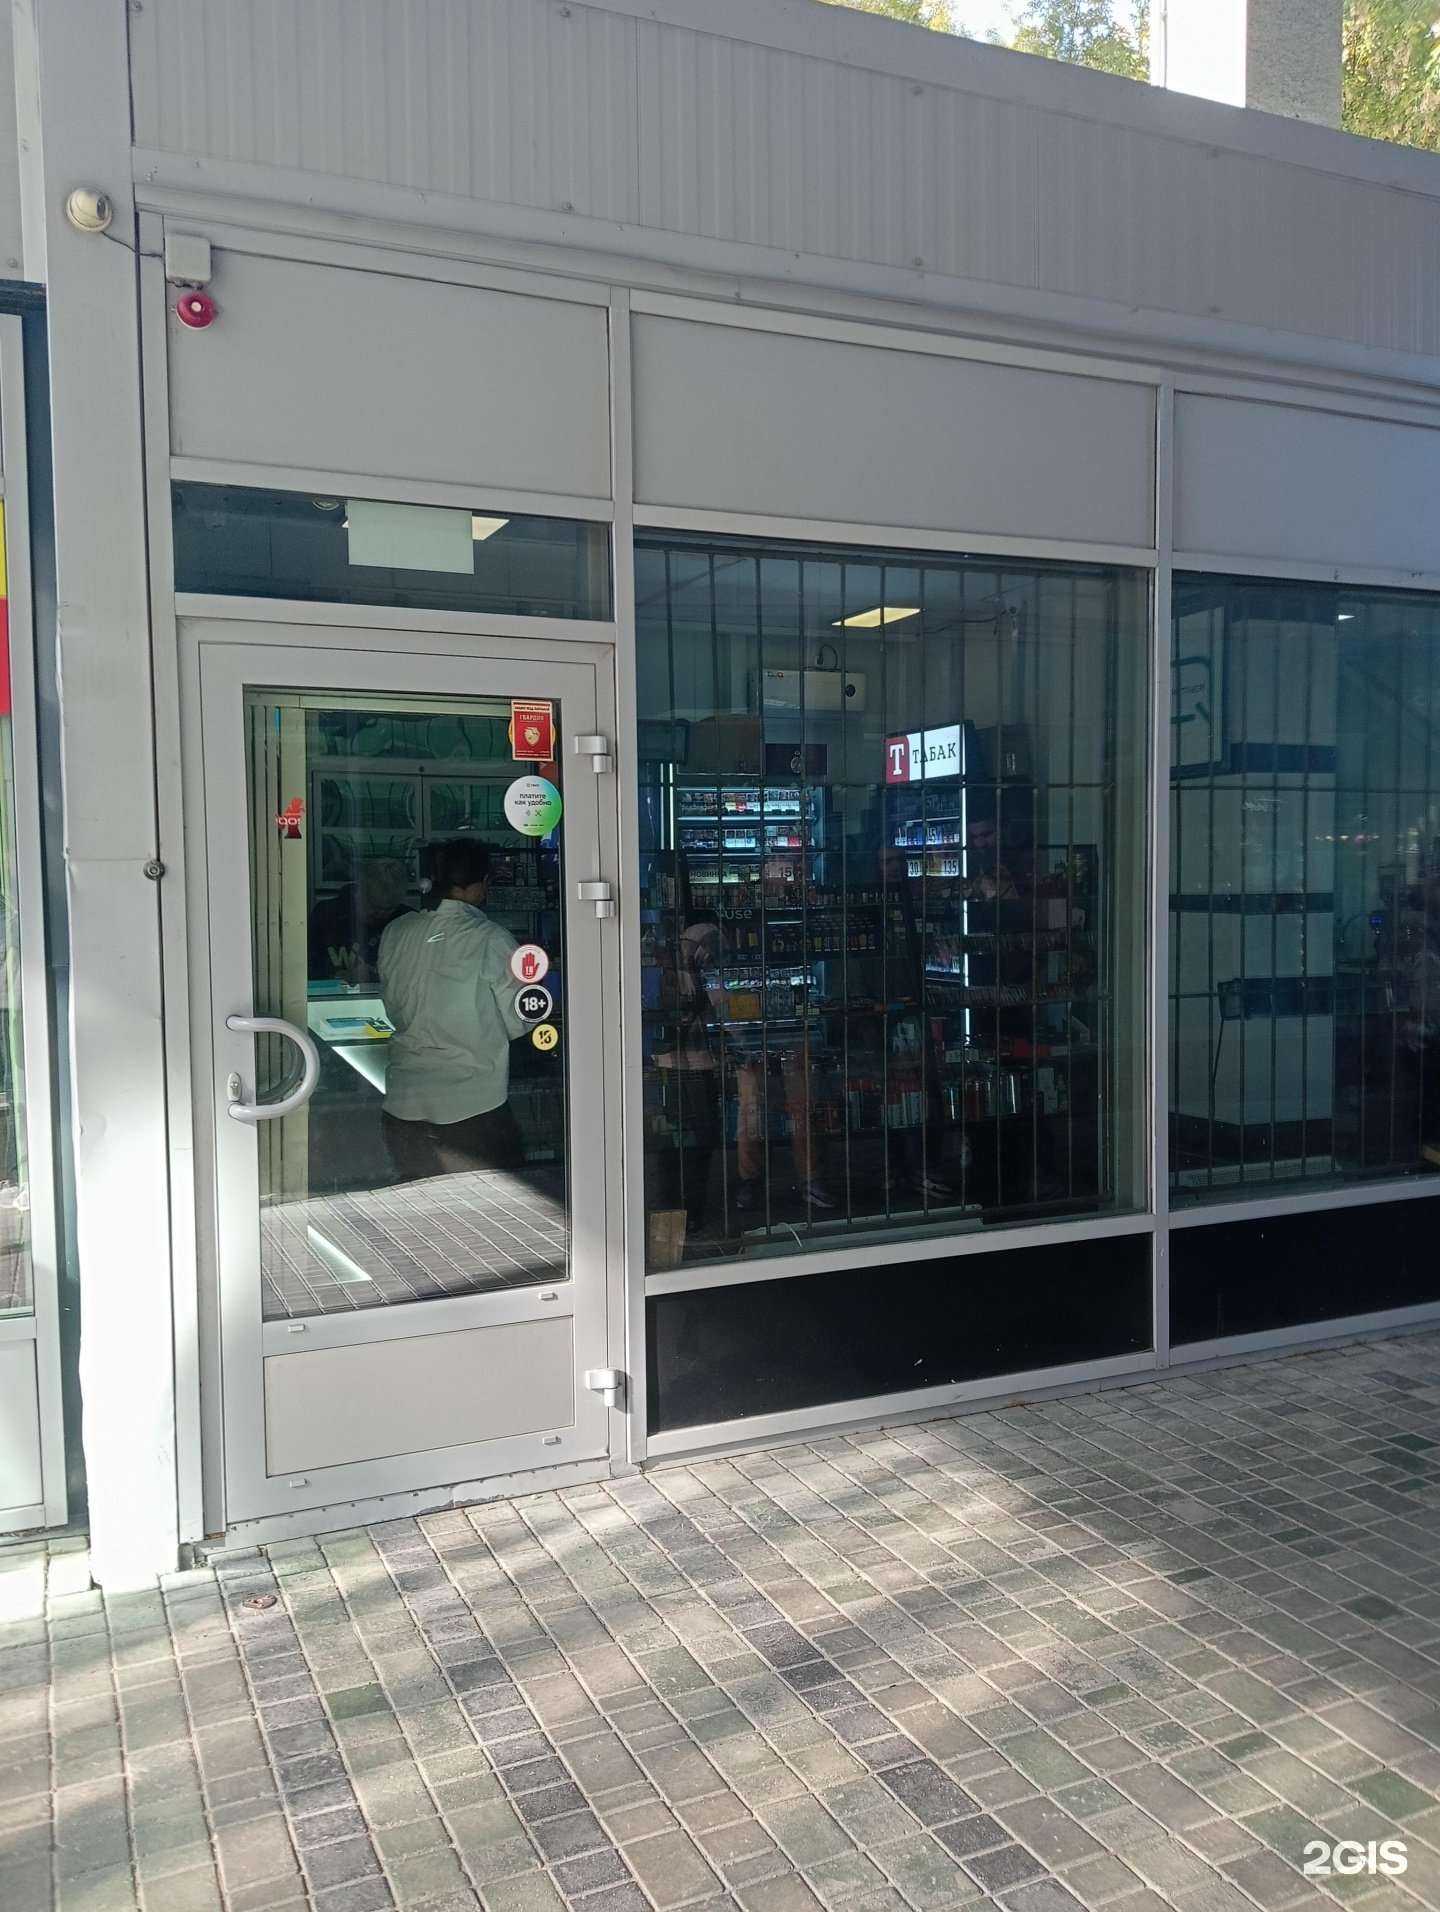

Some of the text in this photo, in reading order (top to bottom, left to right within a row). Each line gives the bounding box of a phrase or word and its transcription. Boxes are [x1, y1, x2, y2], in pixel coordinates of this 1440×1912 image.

[912, 742, 957, 764] ТАБАК
[527, 798, 552, 807] удобно
[688, 870, 728, 879] НОВИНА
[522, 996, 546, 1012] 18+
